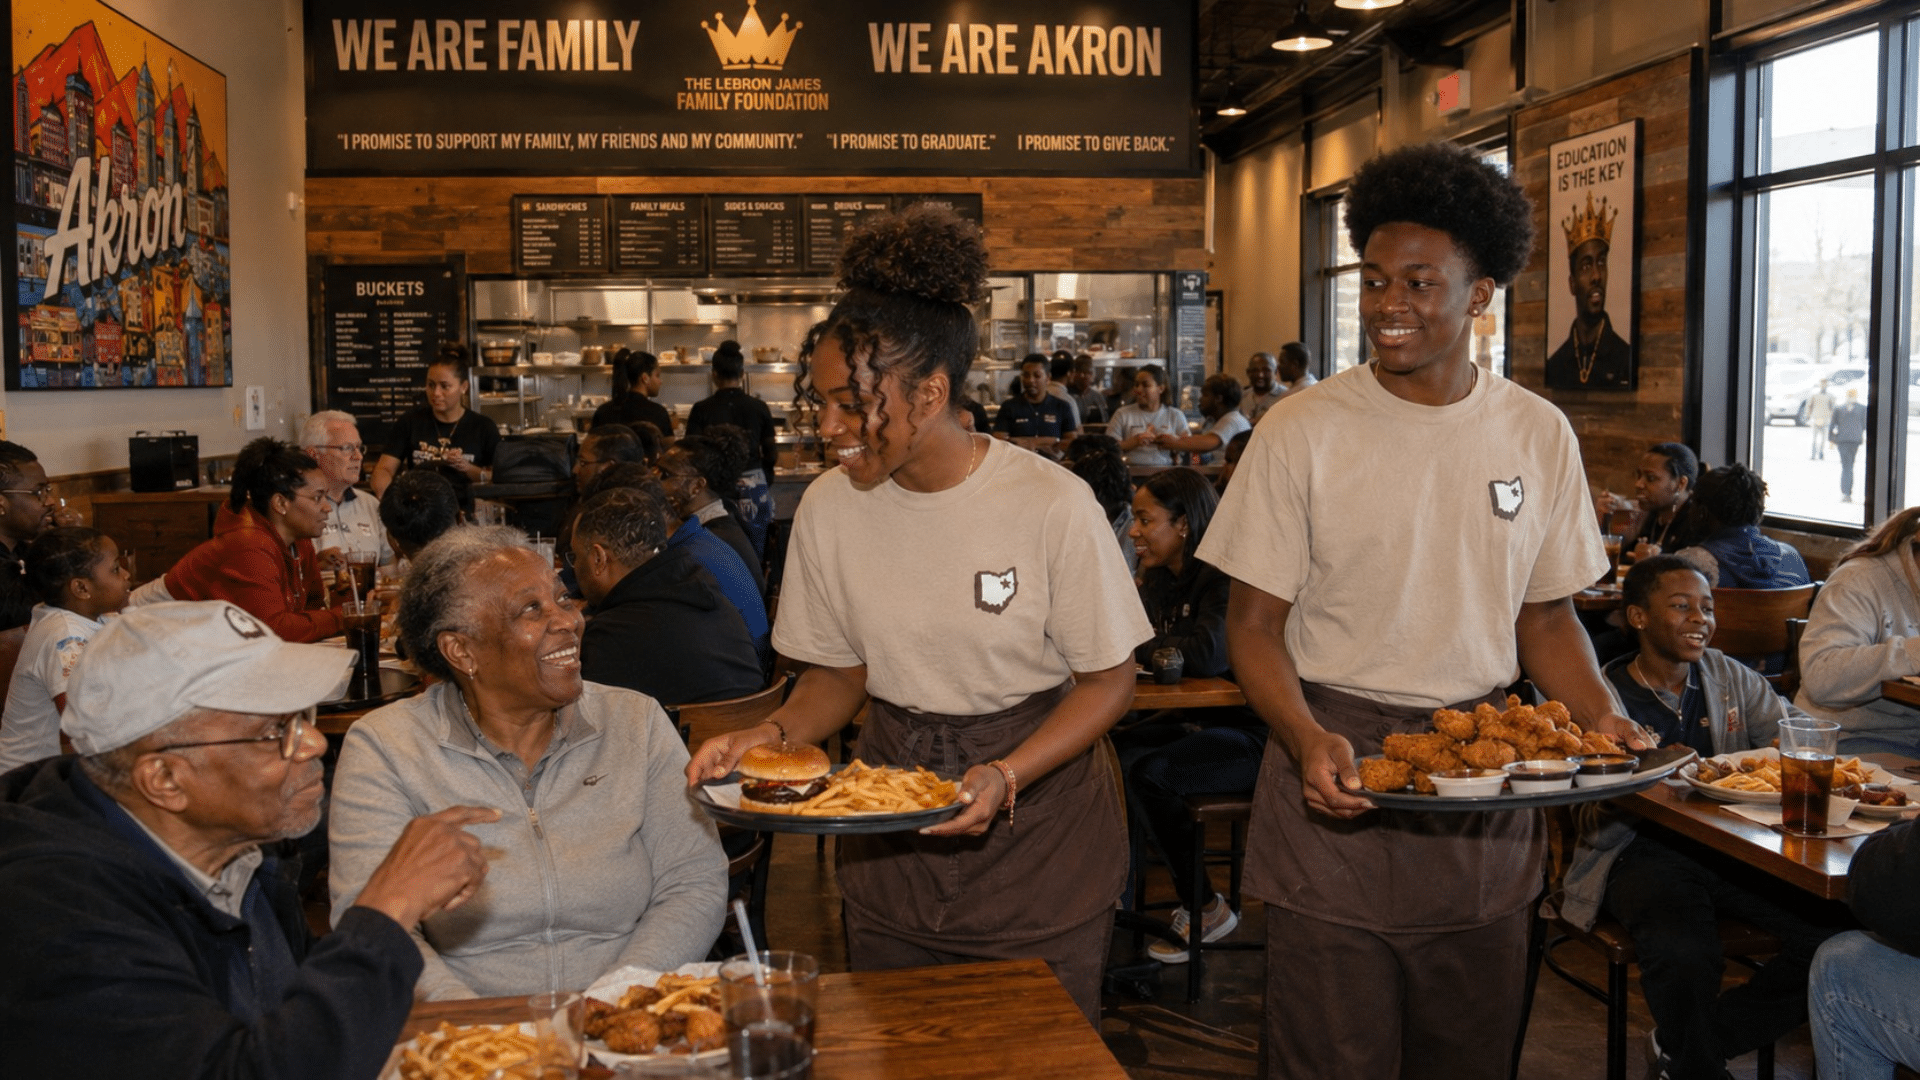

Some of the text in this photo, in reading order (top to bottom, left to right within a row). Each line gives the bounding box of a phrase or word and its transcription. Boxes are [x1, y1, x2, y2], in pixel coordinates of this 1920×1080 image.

[332, 19, 641, 71] WE ARE FAMILY
[868, 22, 1162, 76] WE ARE AKRON
[684, 78, 821, 91] THE LEBRON JAMES
[677, 93, 829, 111] FAMILY FOUNDATION
[352, 133, 412, 150] PROMISE
[414, 133, 433, 150] TO
[436, 133, 497, 150] SUPPORT
[501, 133, 522, 150] MY
[525, 133, 574, 152] FAMILY,
[577, 133, 598, 149] MY
[601, 133, 658, 149] FRIENDS
[661, 133, 689, 149] AND
[691, 133, 712, 149] MY
[840, 133, 899, 150] PROMISE
[901, 133, 919, 150] TO
[1017, 134, 1023, 150] I
[1025, 134, 1082, 151] PROMISE
[1083, 135, 1101, 152] TO
[1103, 135, 1131, 152] GIVE
[1557, 136, 1627, 170] EDUCATION
[1558, 161, 1624, 192] IS THE KEY
[535, 202, 588, 212] SANDWICHES
[630, 202, 686, 212] FAMILY MEALS
[724, 202, 747, 211] SIDES
[44, 156, 186, 299] Akron
[355, 281, 425, 297] BUCKETS
